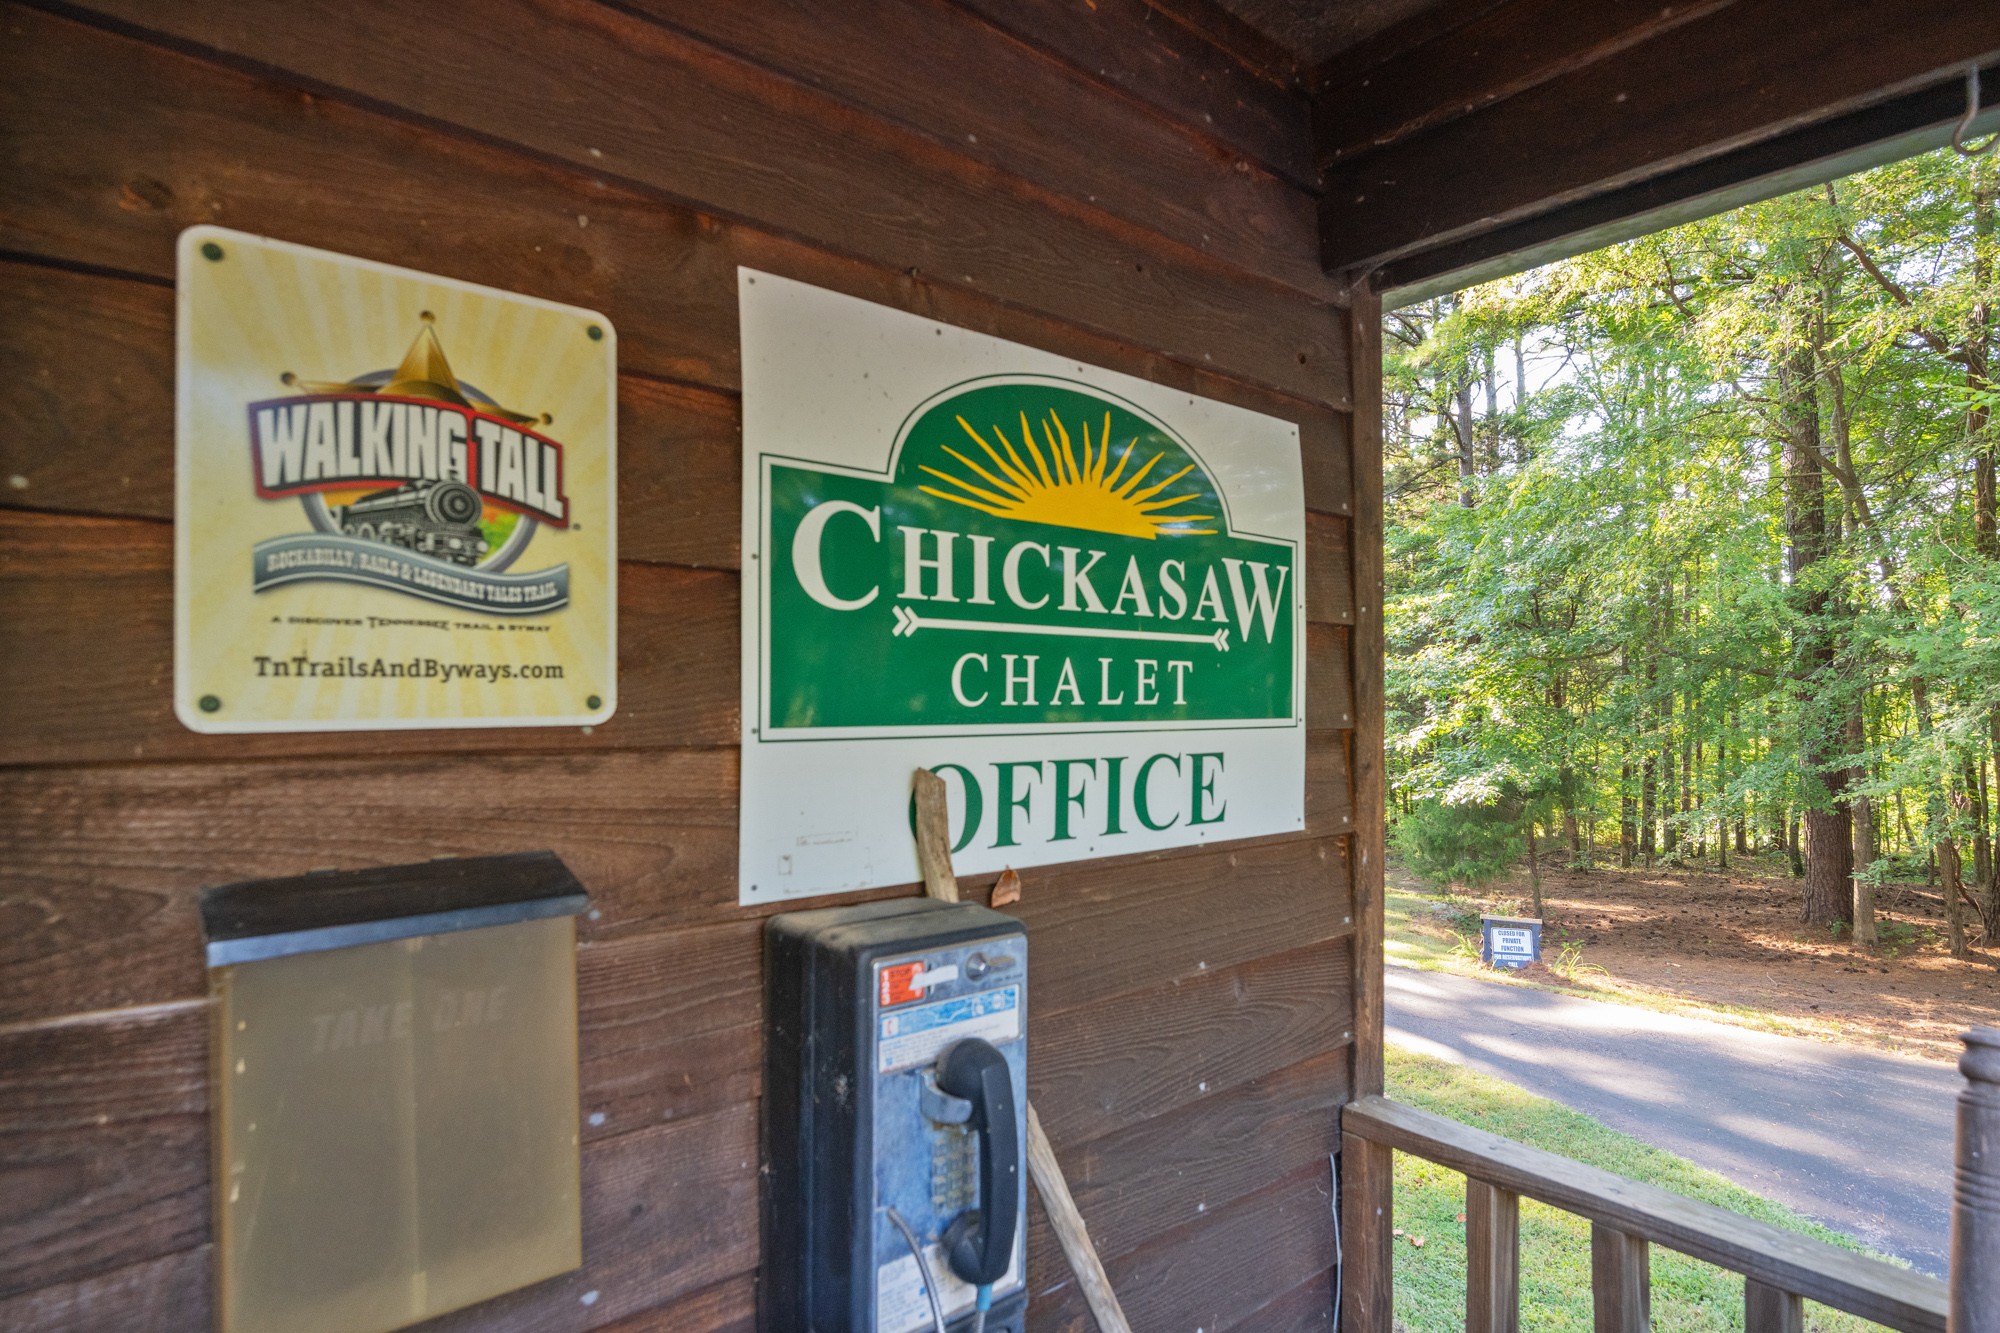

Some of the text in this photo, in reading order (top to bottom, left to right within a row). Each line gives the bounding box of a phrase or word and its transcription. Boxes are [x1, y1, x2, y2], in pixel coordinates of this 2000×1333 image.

[257, 401, 564, 519] WALKING TALL
[792, 500, 1290, 643] CHICKASAW
[253, 656, 565, 683] TnTrailsAndByways.com
[951, 653, 1194, 708] CHALET
[908, 752, 1227, 855] OFFICE
